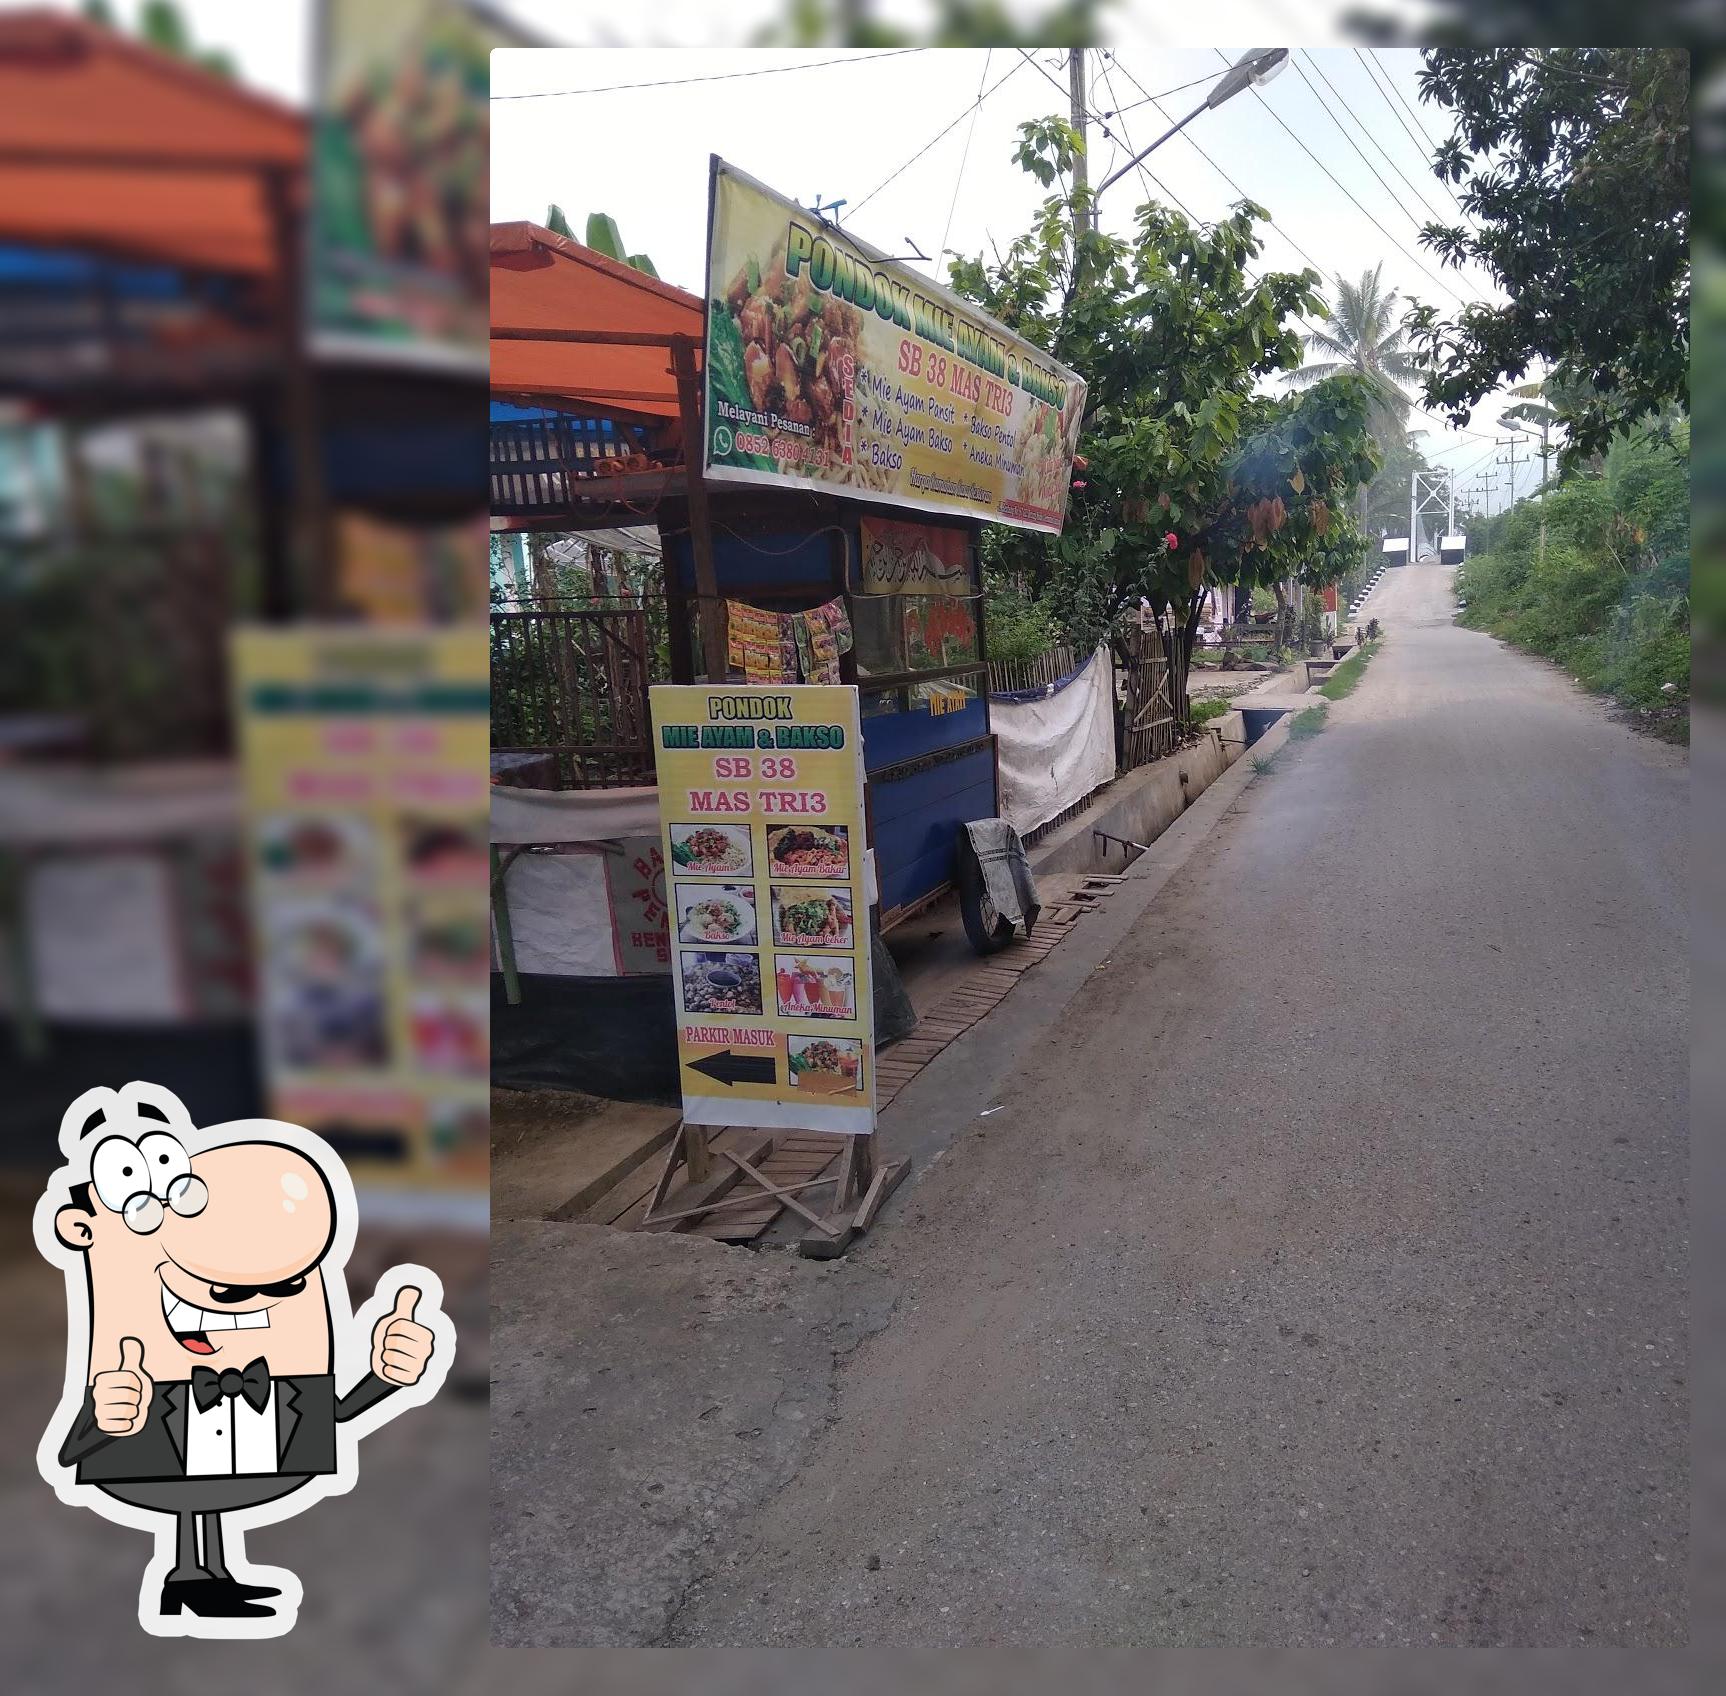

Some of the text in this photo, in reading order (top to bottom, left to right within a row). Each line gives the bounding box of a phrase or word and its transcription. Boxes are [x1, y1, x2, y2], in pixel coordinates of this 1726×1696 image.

[786, 220, 912, 332] PONDOK
[912, 292, 955, 354] MIE
[956, 318, 1006, 379] AYAM
[1021, 356, 1068, 411] BAKSO
[899, 339, 1014, 417] SB 38 MAS TRI3
[842, 354, 857, 465] SEDIA
[872, 375, 955, 425] Mie Ayam Pansit
[717, 400, 811, 437] Melayani Pesanan
[970, 415, 992, 440] Bakso
[872, 410, 953, 453] Mie Ayam Bakso
[734, 431, 770, 458] 0852
[771, 439, 801, 462] 6380
[871, 443, 903, 470] Bakso
[969, 448, 993, 467] Aneka
[708, 695, 793, 720] PONDOK
[661, 725, 845, 750] MIE AYAM & BAKSO
[715, 757, 796, 779] SB 38
[690, 791, 827, 813] MAS TRI3
[788, 864, 816, 875] Ayam
[784, 1001, 852, 1014] Aneka Minuman
[685, 1026, 776, 1046] PARKIR MASUK
